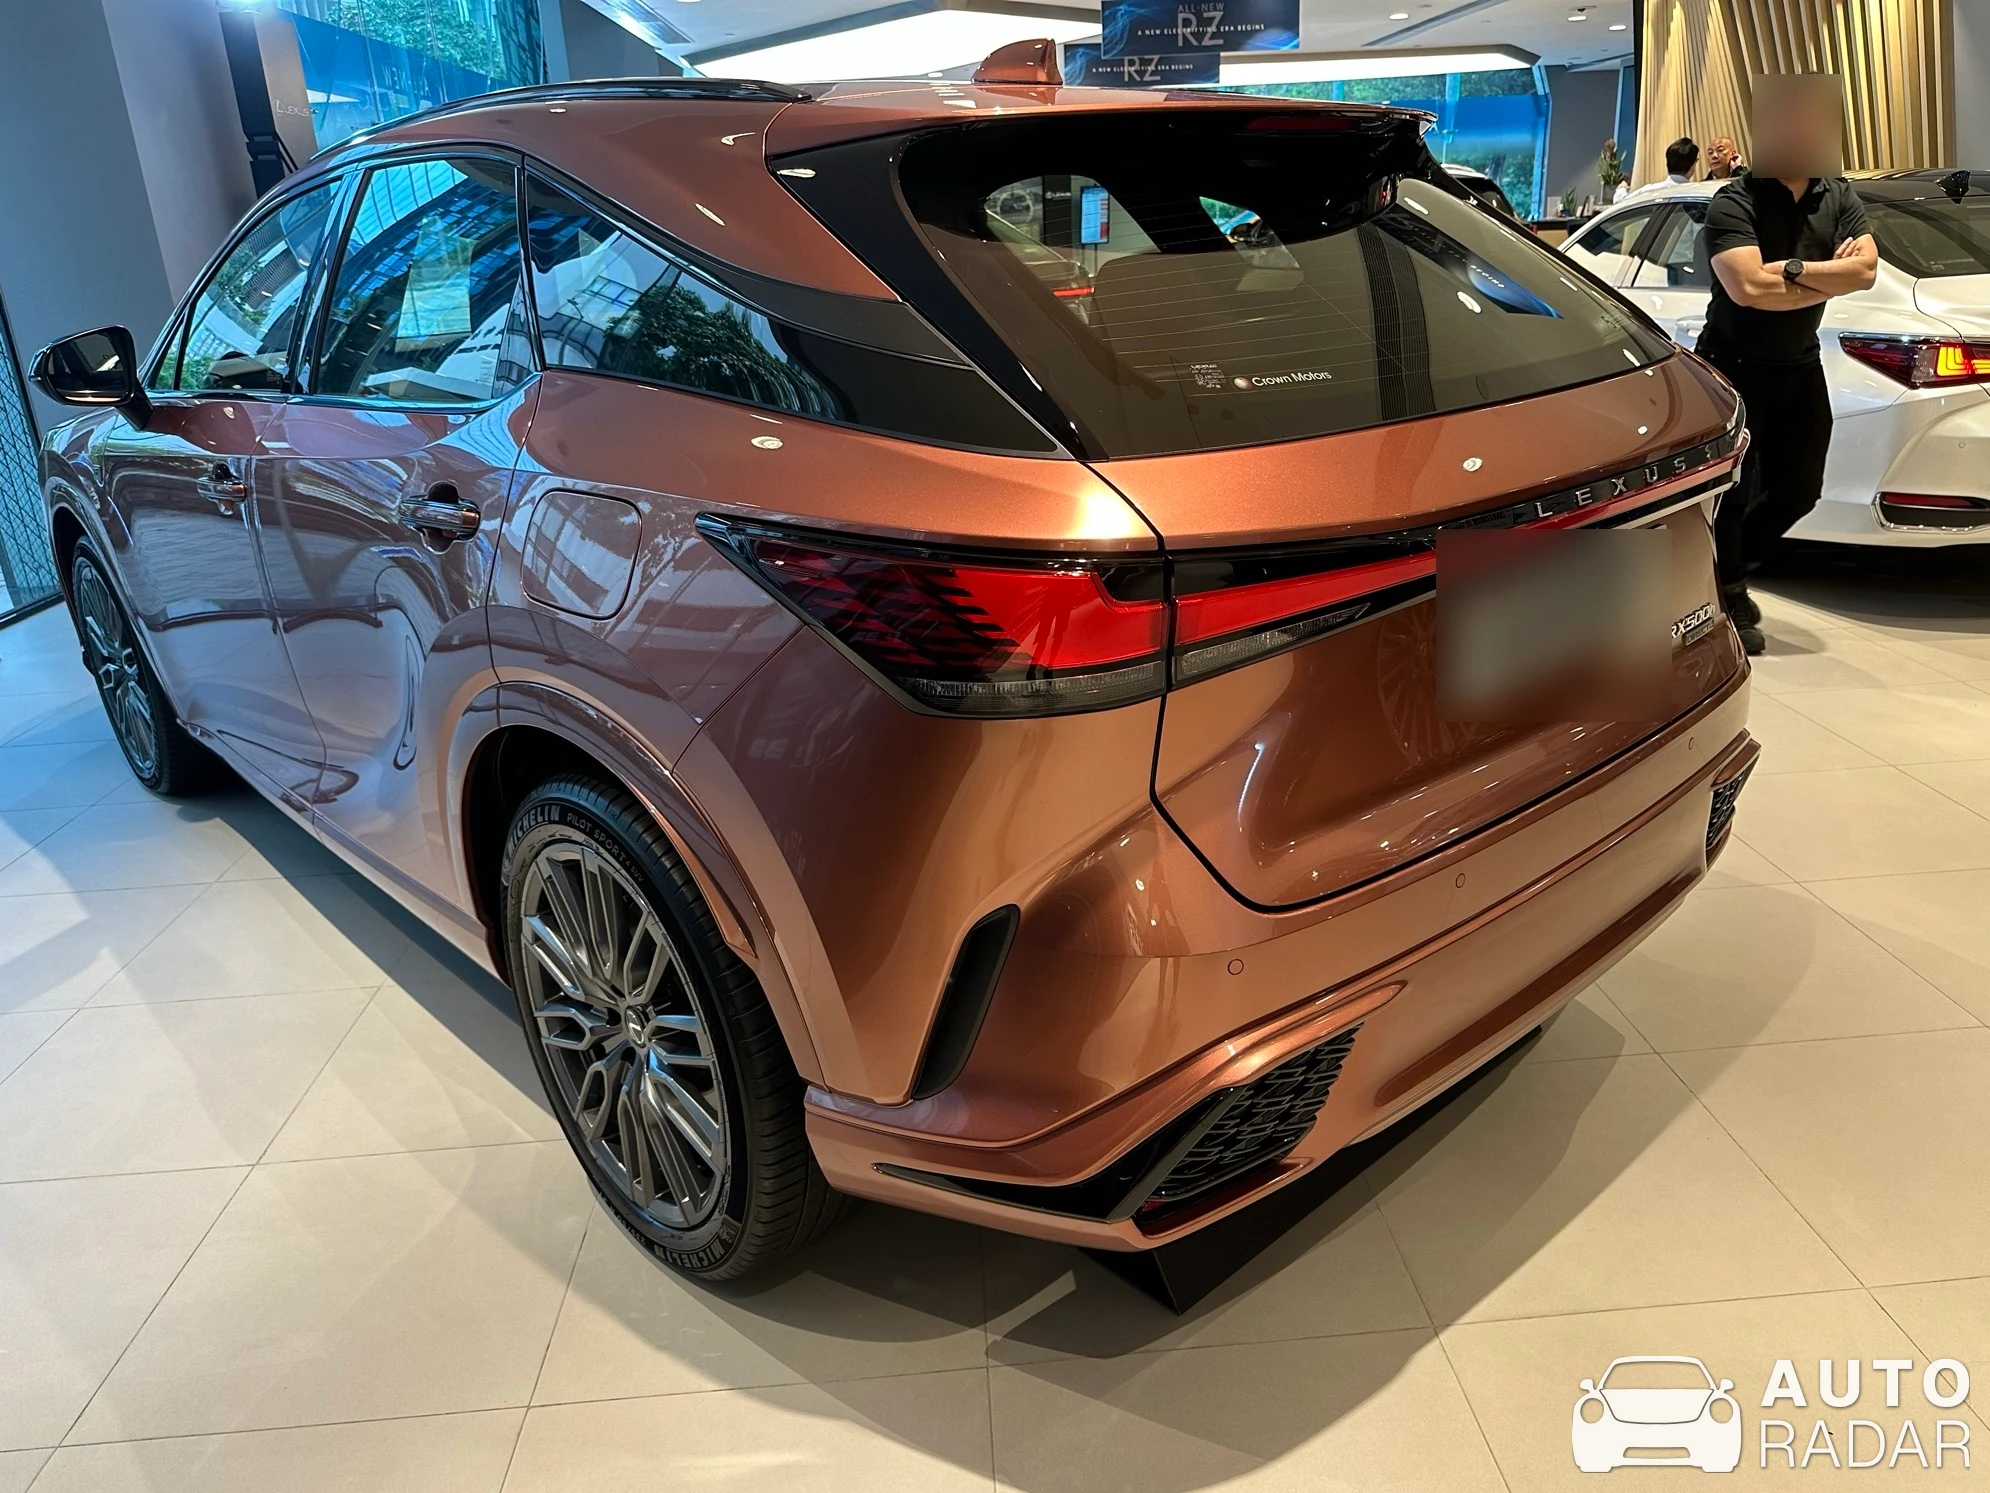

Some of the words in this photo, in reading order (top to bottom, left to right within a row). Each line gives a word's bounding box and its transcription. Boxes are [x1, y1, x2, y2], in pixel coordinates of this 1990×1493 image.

[1178, 3, 1224, 12] ALL-NEW
[1164, 26, 1218, 35] ELECTRIFYING
[1221, 25, 1235, 33] ERA
[1238, 24, 1265, 32] BEGINS
[1178, 12, 1224, 47] RZ
[1124, 55, 1161, 82] RZ
[1251, 374, 1291, 387] Crown
[1290, 371, 1333, 382] Motors
[1535, 456, 1687, 518] LEXUS
[507, 805, 560, 858] MICHELIN
[566, 812, 593, 833] PILOT
[593, 830, 627, 862] SPORT
[653, 1238, 726, 1269] MICHELIN
